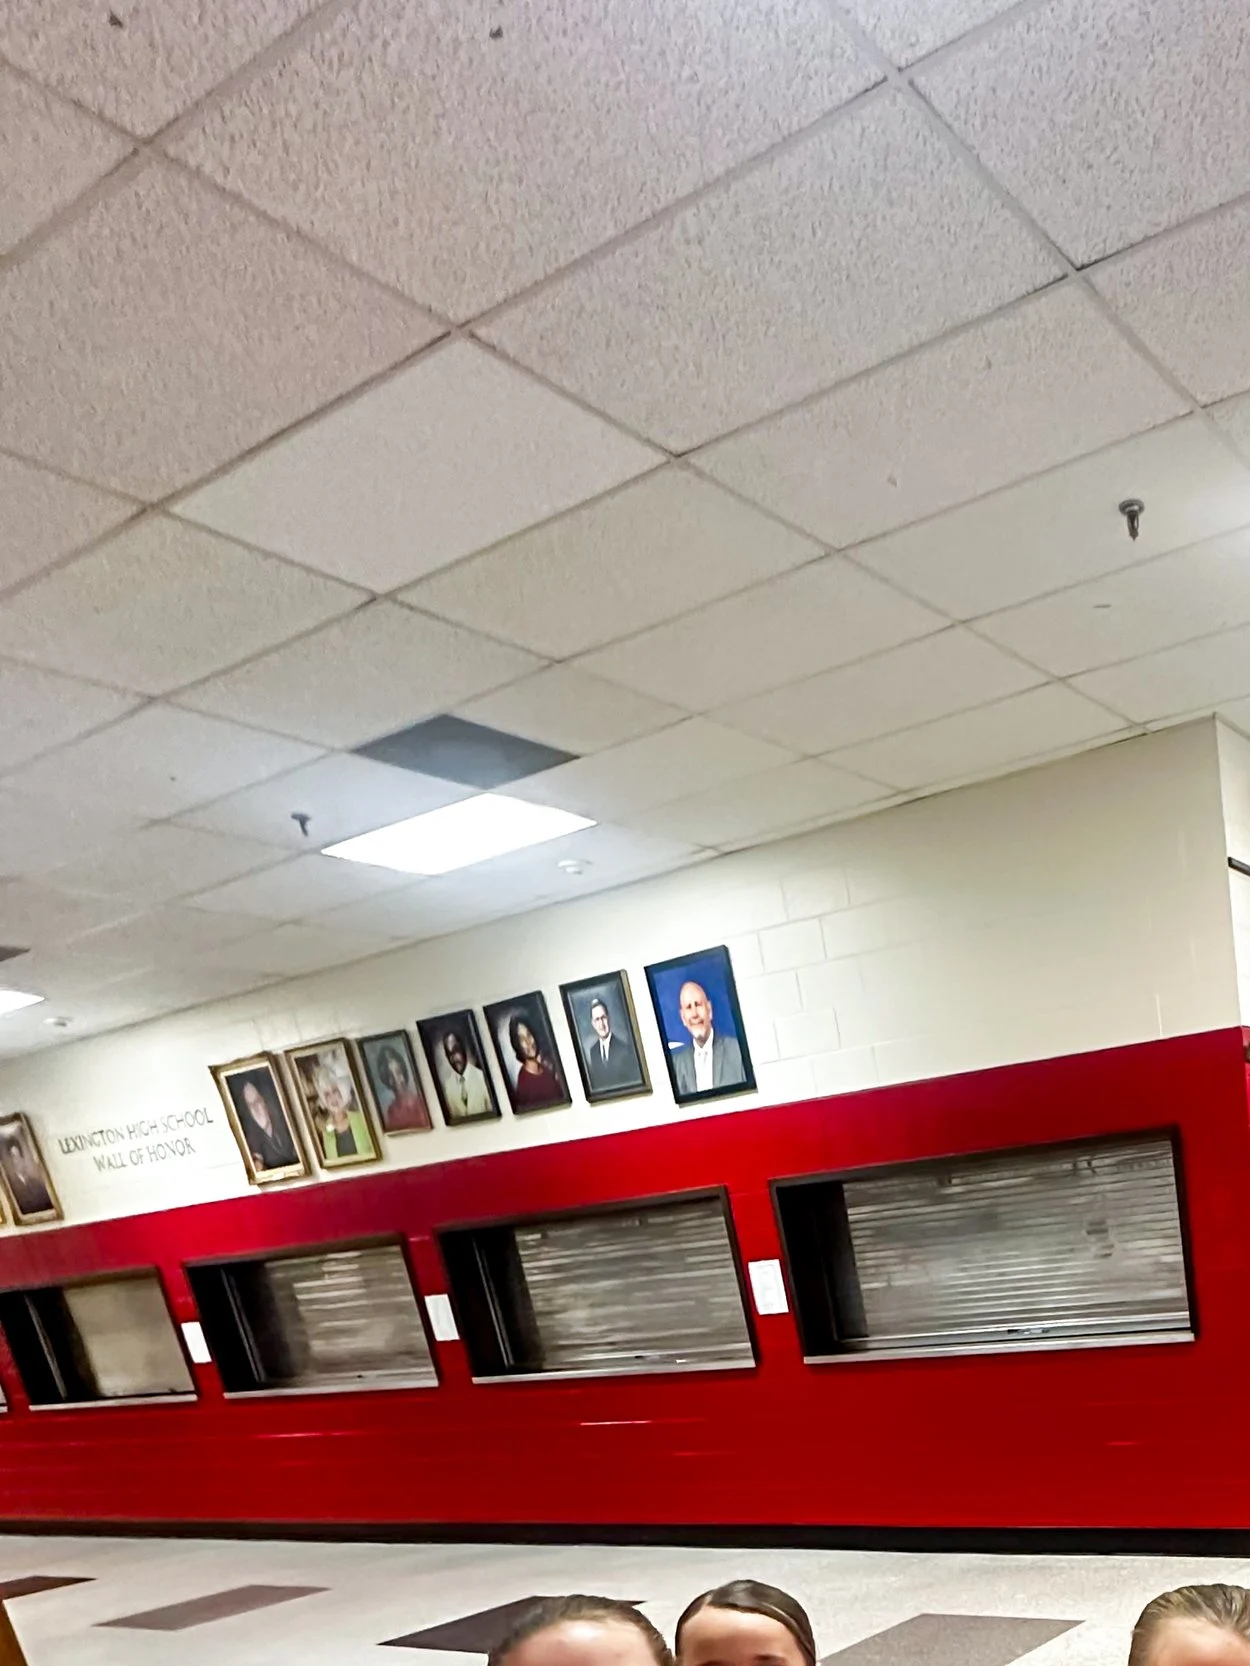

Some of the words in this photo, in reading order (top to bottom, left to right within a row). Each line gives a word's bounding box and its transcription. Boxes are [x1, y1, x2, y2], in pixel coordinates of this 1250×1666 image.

[58, 1129, 125, 1155] LEXINGTON
[126, 1119, 159, 1140] HIGH
[160, 1107, 214, 1134] SCHOOL
[93, 1152, 127, 1173] WALL
[129, 1147, 143, 1166] OF
[145, 1137, 196, 1163] HONOR
